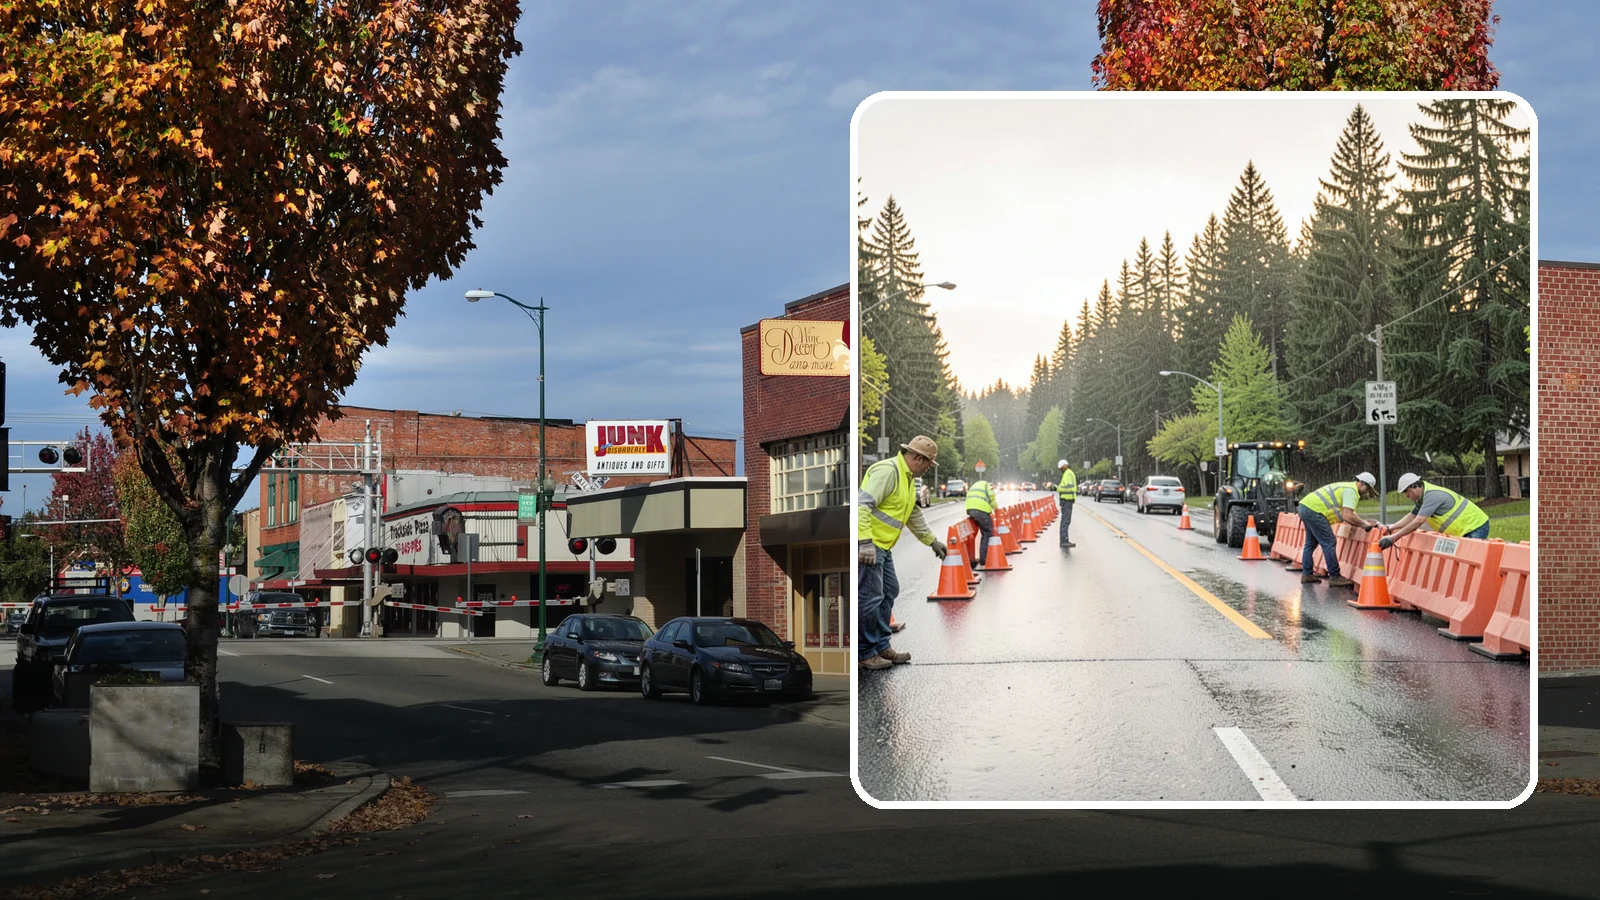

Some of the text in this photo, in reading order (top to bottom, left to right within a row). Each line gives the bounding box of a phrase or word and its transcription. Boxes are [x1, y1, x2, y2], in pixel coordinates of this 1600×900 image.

[595, 425, 664, 457] JUNK
[607, 446, 646, 454] DISORDERLY
[597, 460, 665, 470] ANTIQUES AND GIFTS
